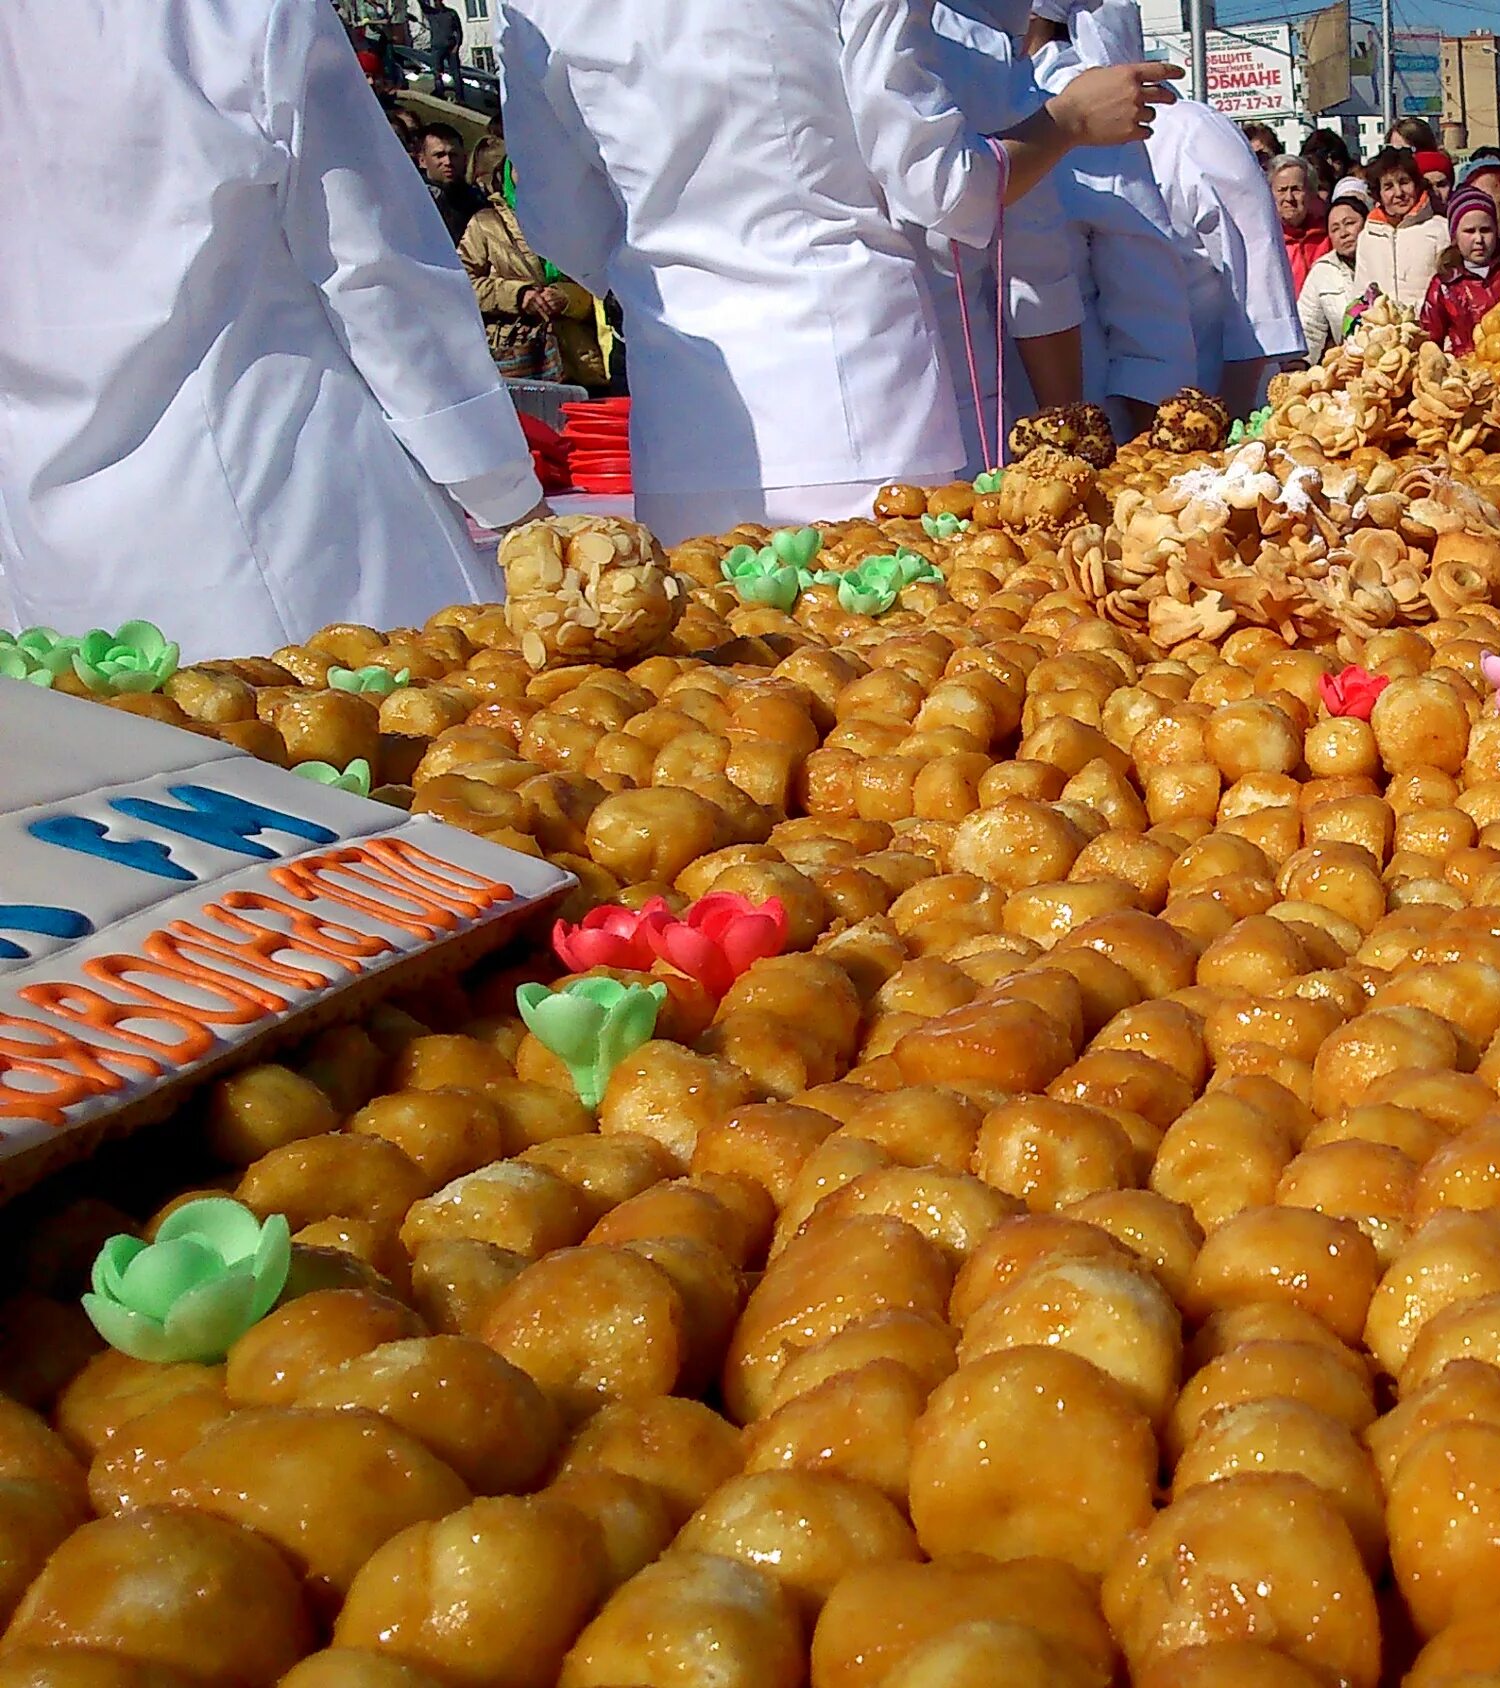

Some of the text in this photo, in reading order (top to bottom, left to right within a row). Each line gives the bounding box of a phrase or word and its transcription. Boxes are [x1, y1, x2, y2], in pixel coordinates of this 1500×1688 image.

[1184, 52, 1253, 67] СБЩИТЕ
[1207, 70, 1281, 90] ОБМАНЕ
[1216, 96, 1283, 112] 237-17-17
